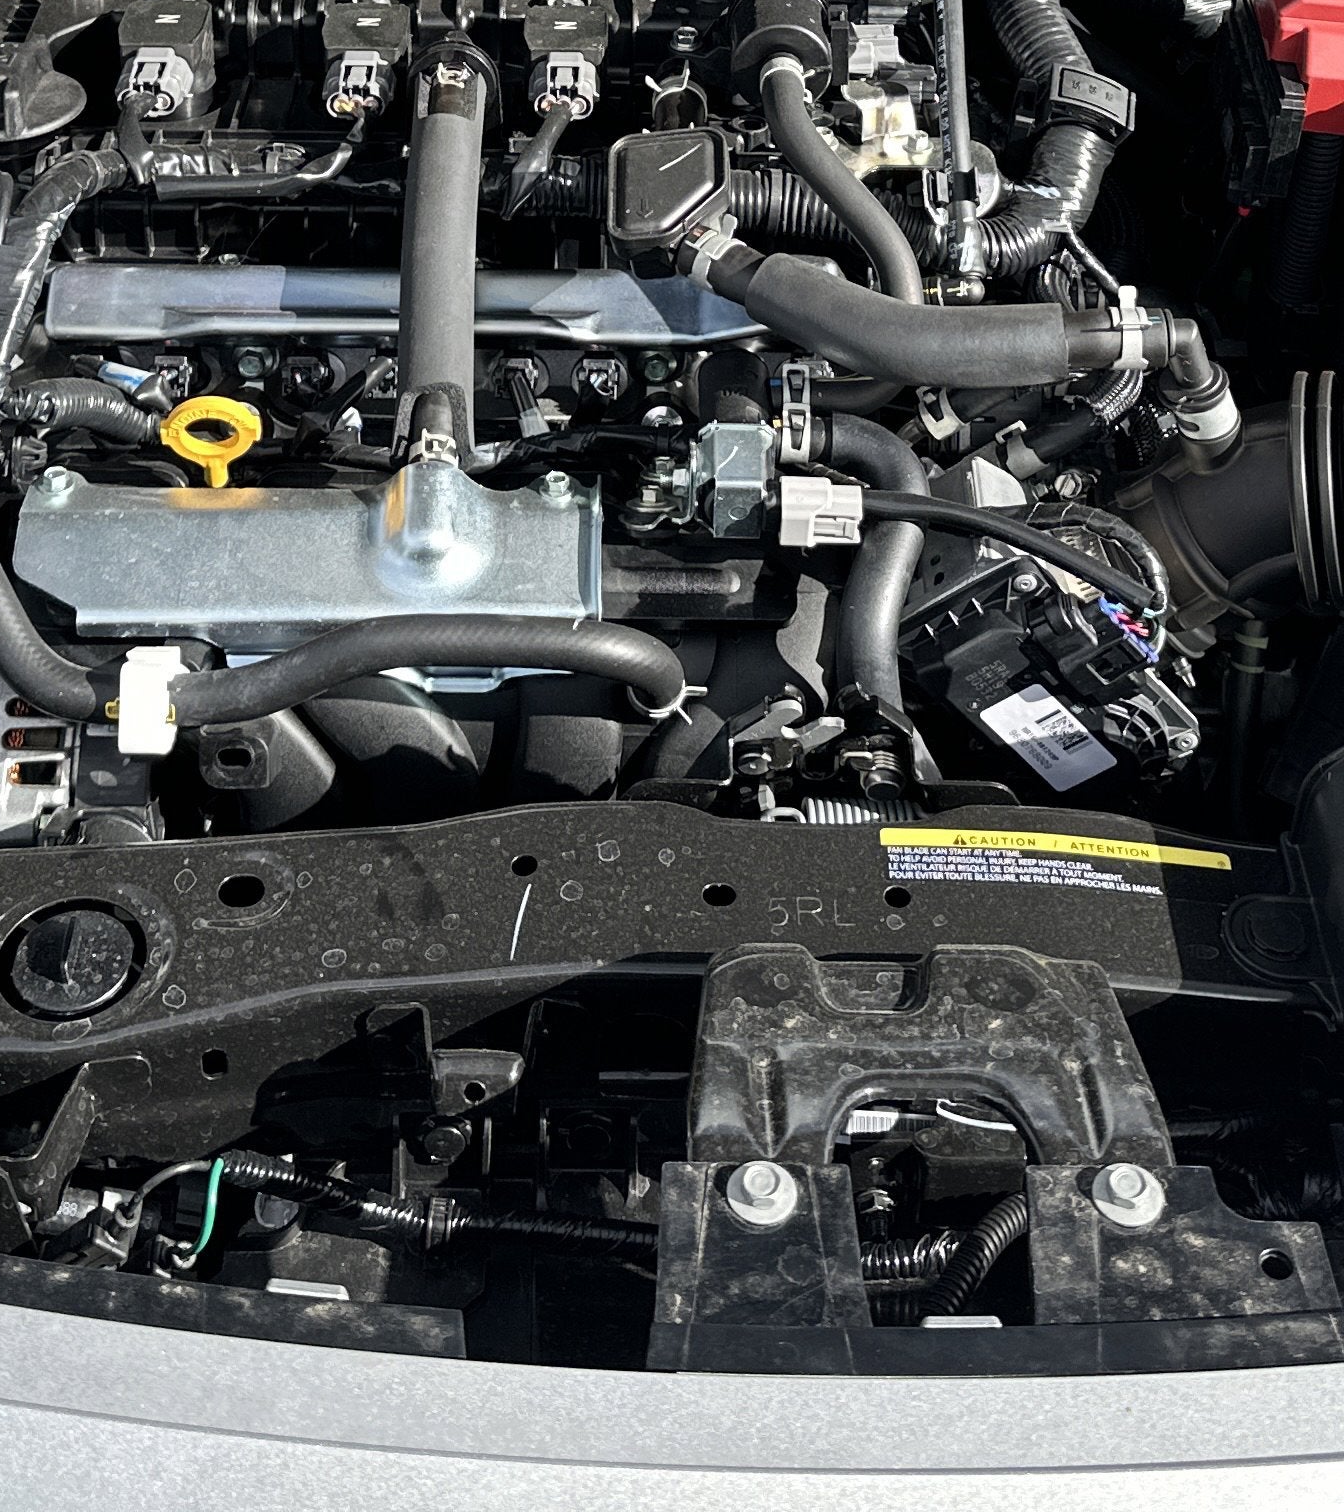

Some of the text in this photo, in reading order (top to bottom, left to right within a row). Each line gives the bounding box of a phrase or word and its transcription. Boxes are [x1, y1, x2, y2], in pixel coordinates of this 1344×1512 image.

[930, 847, 947, 855] CAN
[948, 848, 972, 856] START
[969, 836, 1036, 846] CAUTION
[1070, 841, 1150, 858] ATTENTION
[888, 854, 900, 862] TO
[901, 855, 921, 863] HELP
[922, 855, 946, 863] AVOID
[947, 856, 988, 865] PERSONAL
[1018, 858, 1037, 866] KEEP
[1038, 859, 1066, 868] HANDS
[900, 863, 956, 872] VENTILATEUR
[957, 864, 989, 873] RISQUE
[989, 865, 1002, 873] DE
[1060, 869, 1082, 879] TOUT
[889, 871, 914, 880] POUR
[946, 872, 973, 881] TOUTE
[1019, 875, 1032, 883] NE
[1033, 875, 1049, 884] PAS
[1051, 876, 1063, 885] EN
[1064, 877, 1115, 890] APPROCHER
[1116, 882, 1132, 892] LES
[768, 897, 857, 927] 5RL
